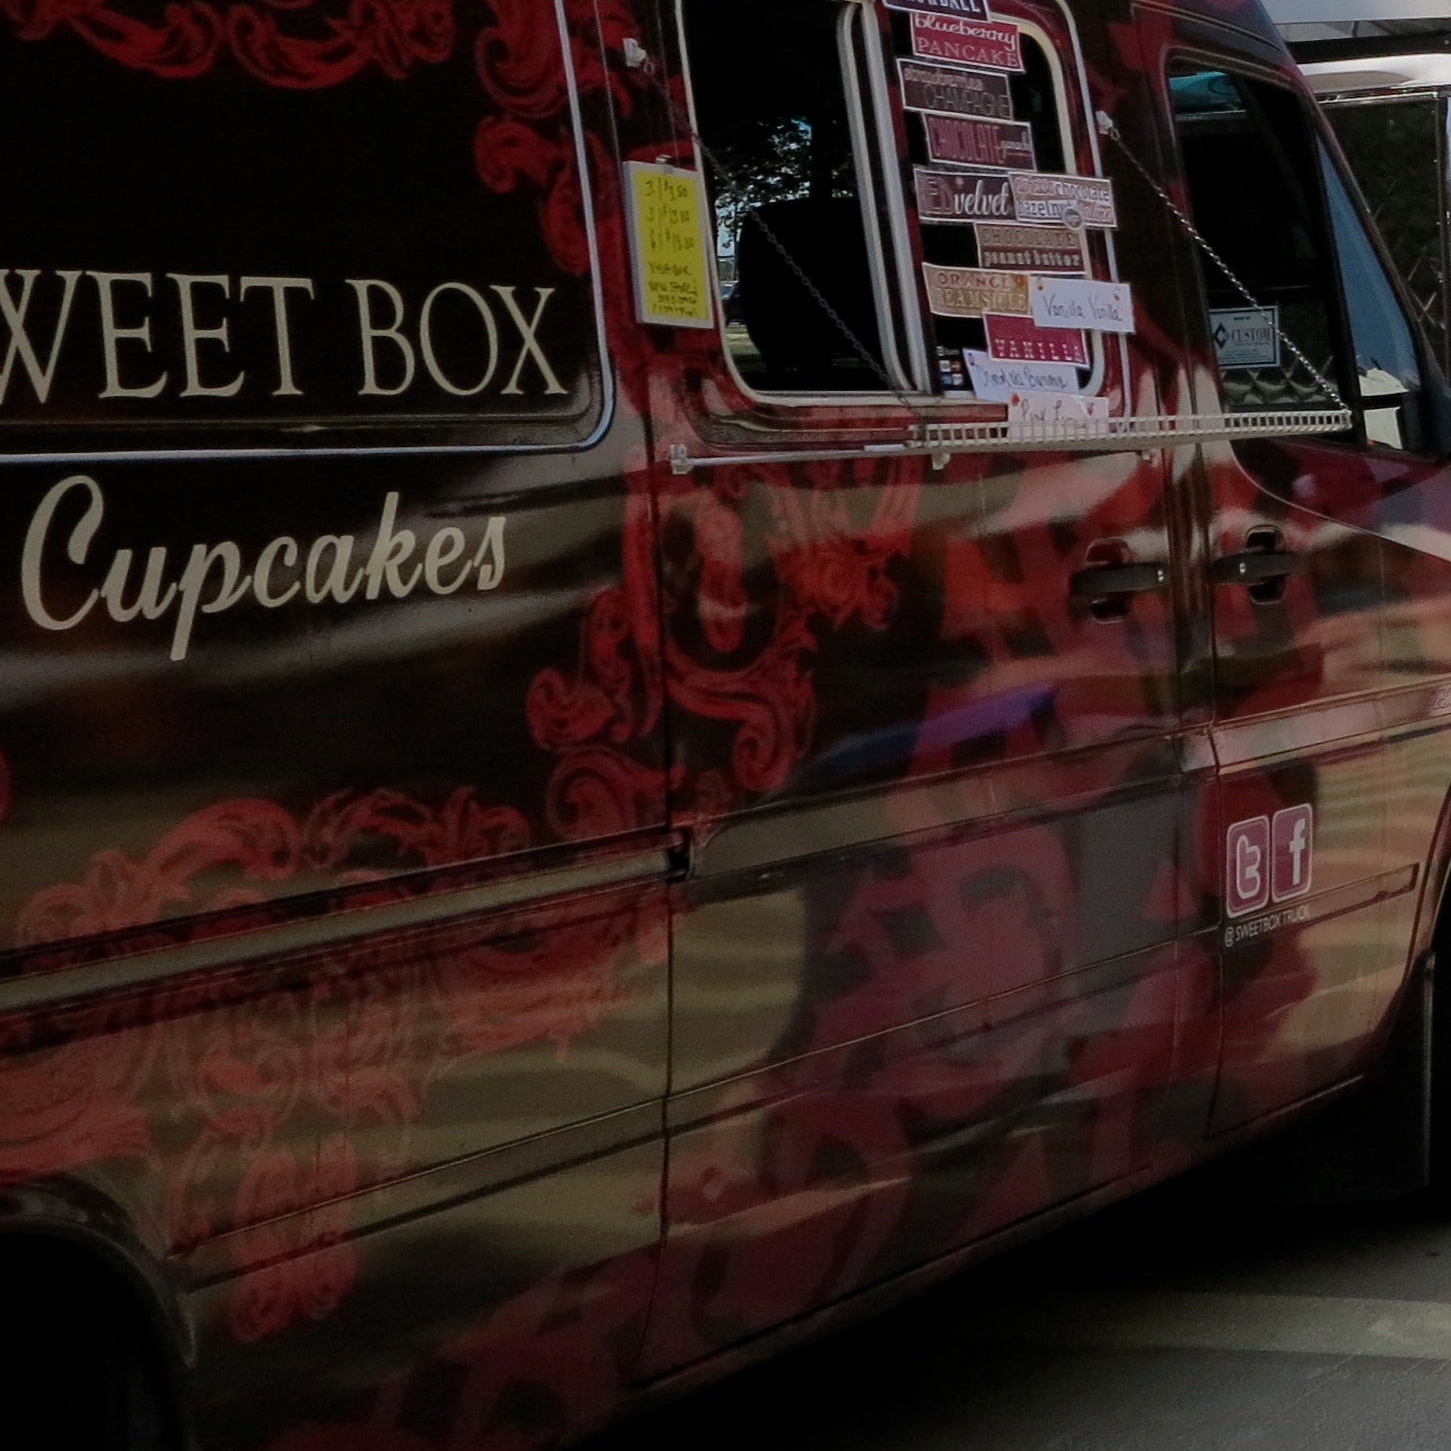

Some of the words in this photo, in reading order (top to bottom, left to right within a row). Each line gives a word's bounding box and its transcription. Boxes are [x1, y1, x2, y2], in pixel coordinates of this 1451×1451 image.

[915, 12, 1016, 51] blueberry
[917, 37, 1018, 68] PANCAKE
[954, 179, 1011, 216] velvet
[345, 278, 569, 396] BOX
[995, 338, 1084, 362] VANILLA
[20, 474, 508, 662] Cupcakes
